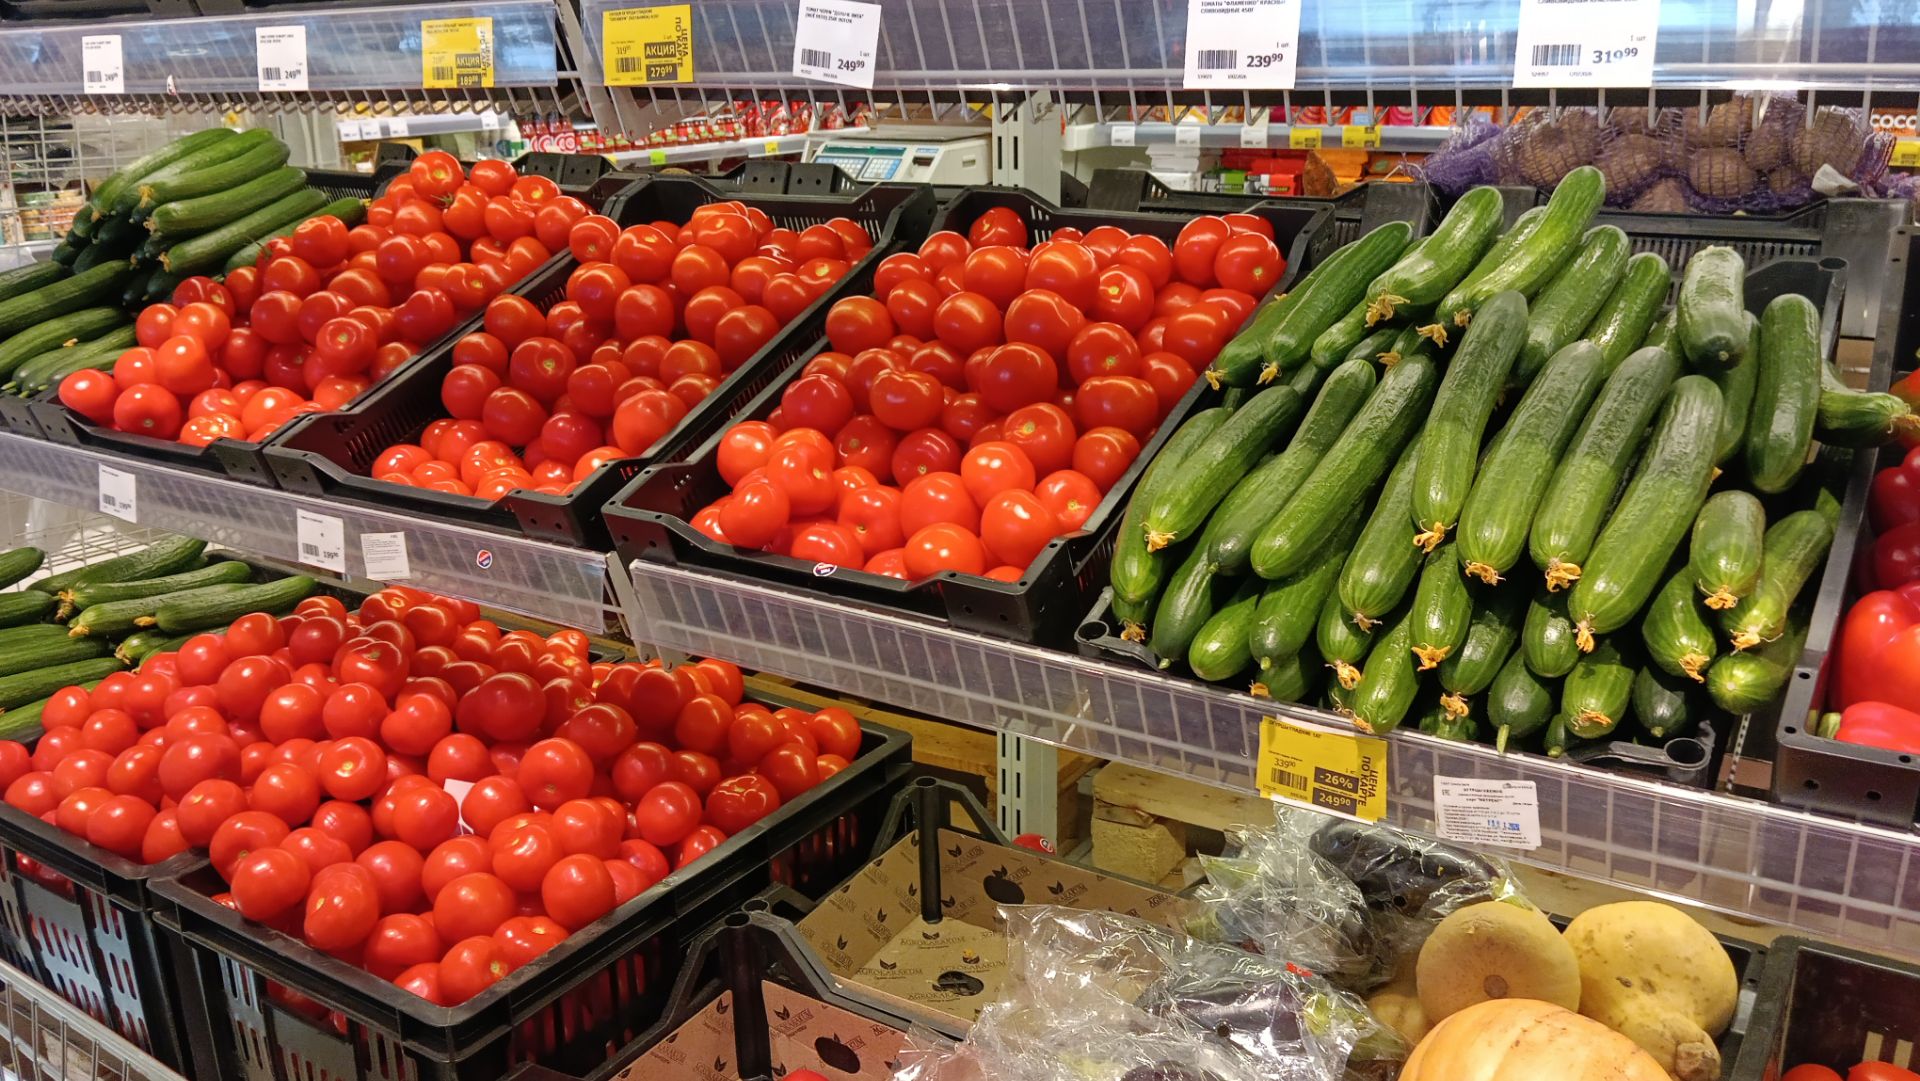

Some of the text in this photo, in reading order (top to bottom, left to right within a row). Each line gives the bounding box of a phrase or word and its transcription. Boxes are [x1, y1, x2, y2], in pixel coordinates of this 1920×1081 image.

[675, 16, 684, 67] ПО КАРТЕ
[646, 45, 675, 57] АКЦИЯ
[456, 55, 480, 68] АКЦИЯ
[837, 58, 865, 72] 24999
[1246, 53, 1283, 68] 23999
[1319, 773, 1354, 790] -26%
[1358, 755, 1371, 807] ПО КАРТЕ
[1368, 770, 1379, 799] ЦЕНА
[1319, 792, 1351, 807] 24990
[856, 967, 924, 976] AGROKARAKUM
